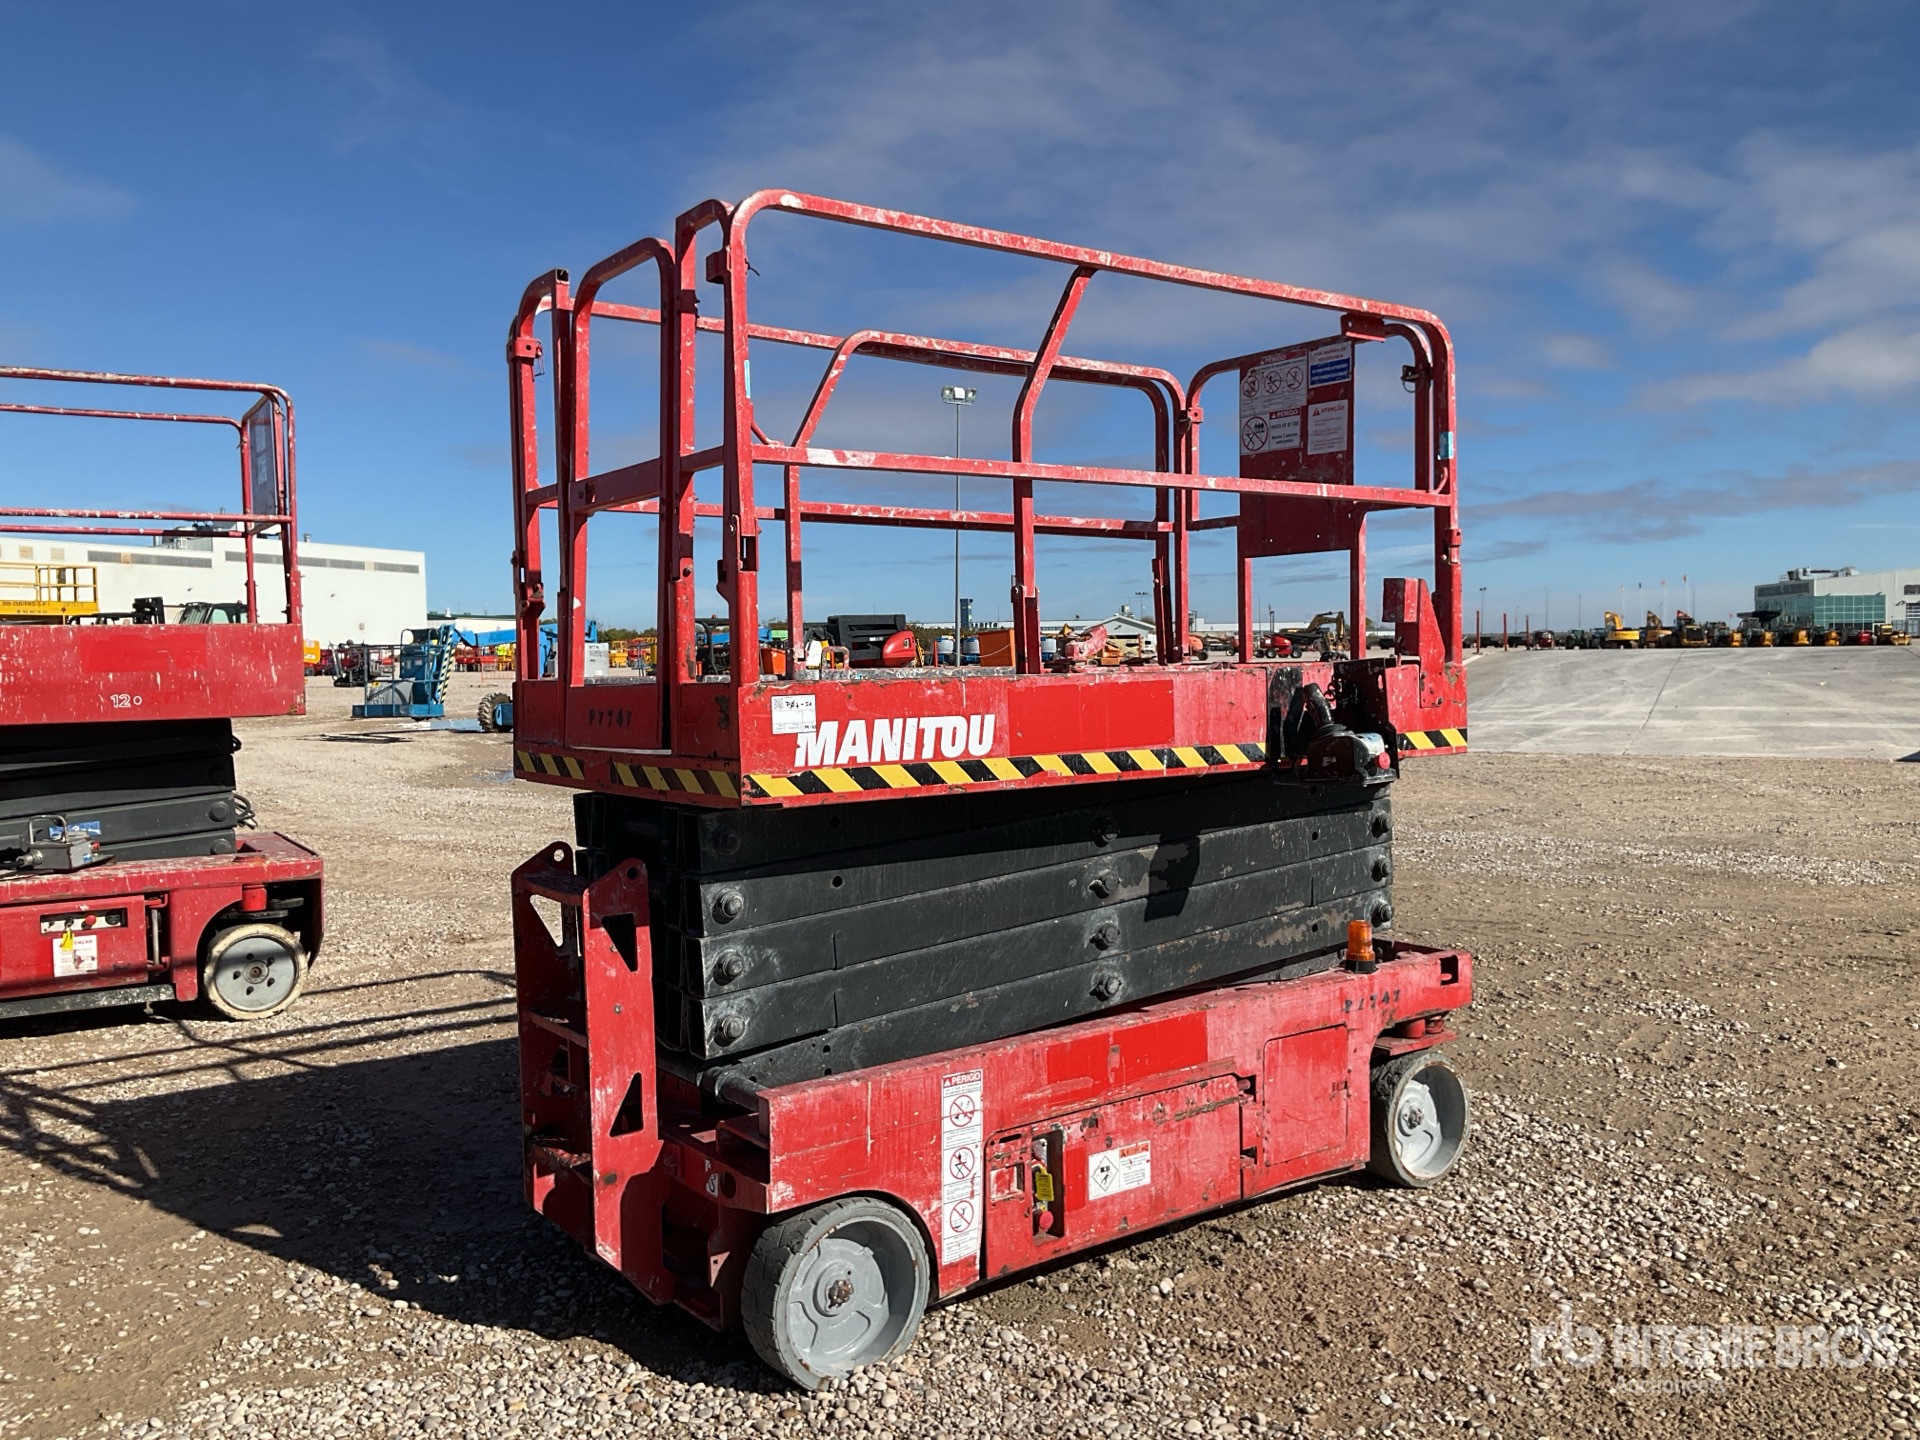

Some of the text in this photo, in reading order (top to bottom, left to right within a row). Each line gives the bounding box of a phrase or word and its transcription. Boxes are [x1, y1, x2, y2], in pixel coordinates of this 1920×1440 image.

[1276, 408, 1299, 418] PERIGO
[794, 714, 995, 767] MANITOU
[951, 1071, 981, 1086] PERIGO
